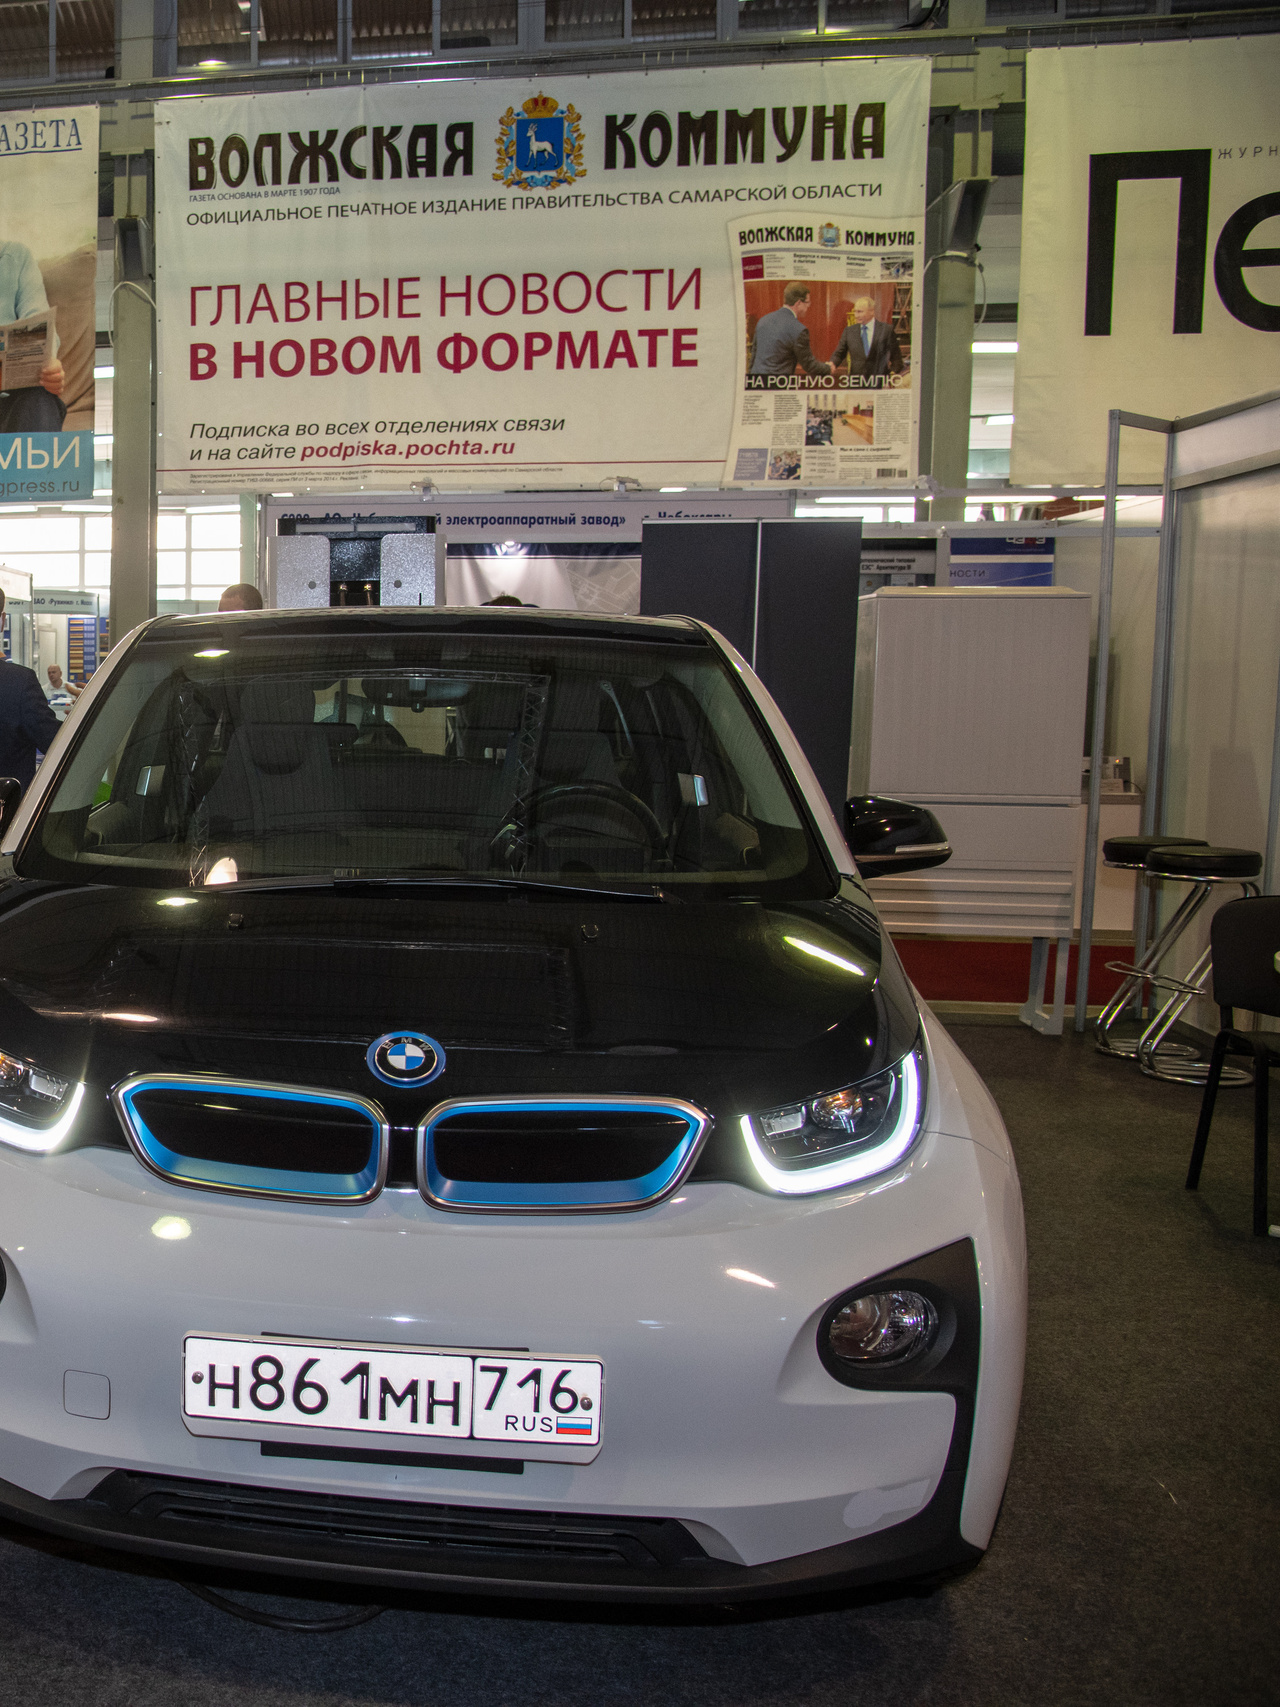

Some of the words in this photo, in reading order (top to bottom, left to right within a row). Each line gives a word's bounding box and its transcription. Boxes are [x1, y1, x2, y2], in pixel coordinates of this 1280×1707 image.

[188, 120, 475, 191] ВОЛЖСКАЯ
[604, 101, 886, 170] КОММУНА
[186, 206, 323, 226] ОФИЦИАЛЬНОЕ
[327, 201, 418, 219] ПЕЧАТНОЕ
[422, 198, 508, 217] ИЗДАНИЕ
[512, 191, 663, 210] ПРАВИТЕЛЬСТВА
[668, 184, 787, 204] САМАРСКОЙ
[792, 183, 883, 200] ОБЛАСТИ
[189, 193, 216, 203] ГАЗЕТА
[217, 190, 261, 201] ОСНОВАНА
[270, 188, 297, 198] МАРТЕ
[299, 187, 317, 197] 1907
[319, 186, 341, 196] ГОДА
[738, 226, 813, 246] ВОЛЖСКАЯ
[845, 229, 915, 246] КОММУНА
[189, 276, 421, 327] ГЛАВНЫЕ
[438, 267, 703, 318] НОВОСТИ
[189, 342, 218, 381] В
[232, 334, 422, 380] НОВОМ
[436, 327, 699, 374] ФОРМАТЕ
[745, 375, 765, 388] НА
[767, 374, 835, 390] РОДНУЮ
[838, 374, 903, 388] ЗЕМЛЮ
[190, 422, 290, 441] Подписка
[295, 424, 320, 437] во
[325, 421, 370, 435] всех
[374, 418, 498, 436] отделениях
[503, 417, 566, 433] связи
[189, 447, 202, 461] и
[207, 446, 232, 461] на
[236, 443, 296, 460] сайте
[300, 440, 516, 461] podpiska.pochta.ru
[446, 513, 577, 529] электроаппаратный
[581, 514, 626, 528] завод»
[381, 1037, 433, 1051] BMW
[479, 1365, 579, 1414] 716
[504, 1415, 553, 1433] RUS
